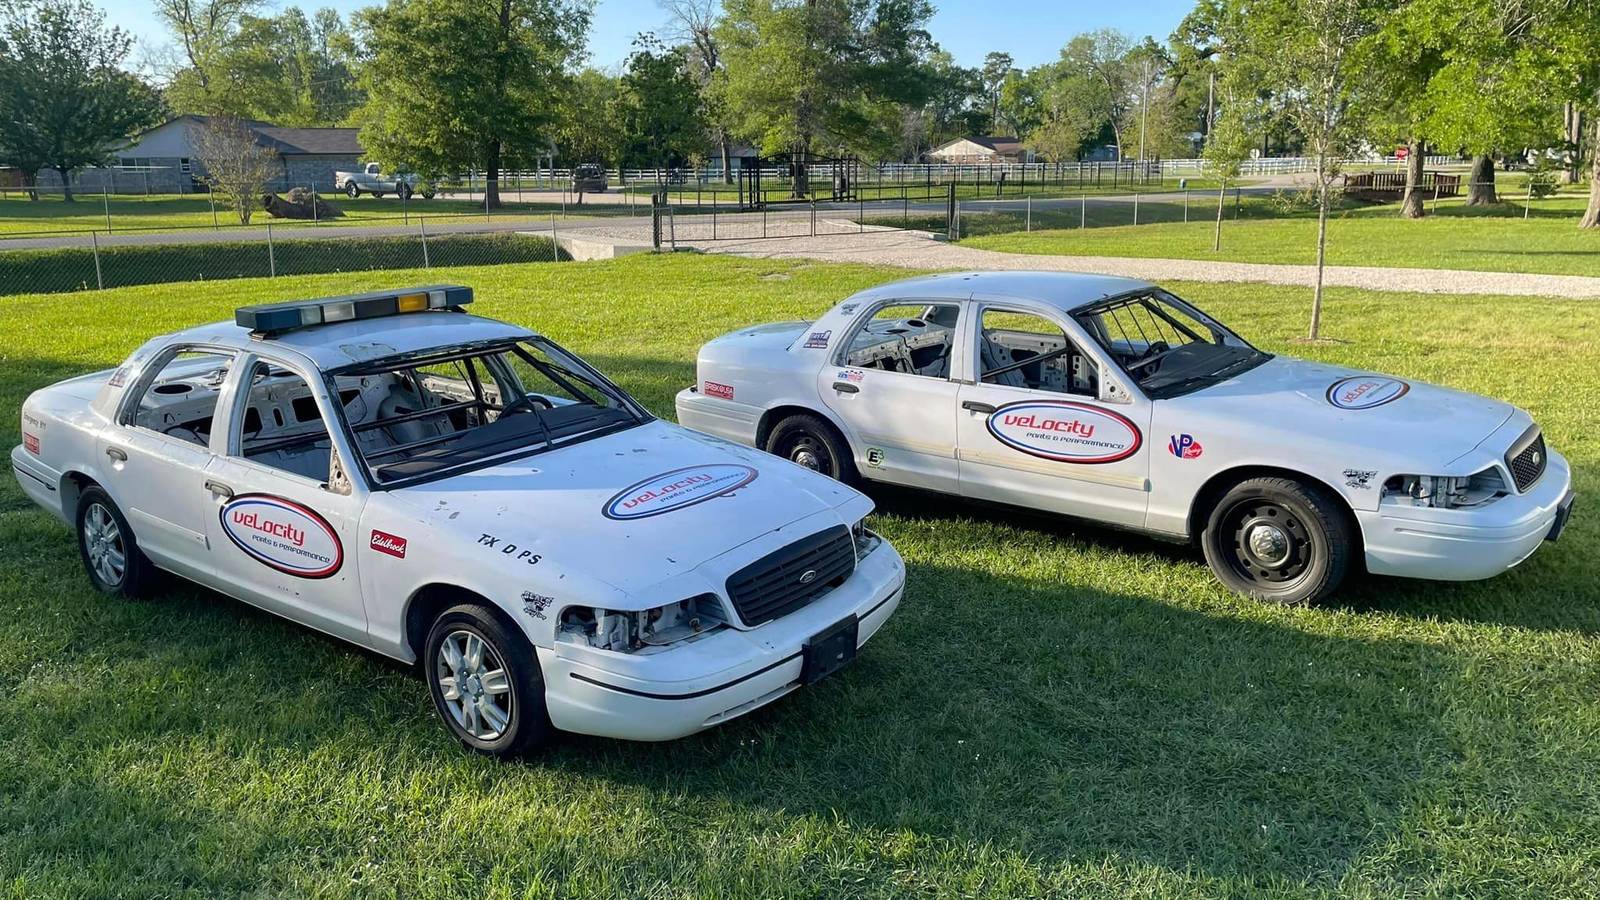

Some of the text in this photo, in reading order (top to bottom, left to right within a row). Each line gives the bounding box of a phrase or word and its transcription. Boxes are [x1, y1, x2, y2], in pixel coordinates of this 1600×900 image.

[1171, 434, 1193, 458] VP
[372, 534, 405, 554] Edelbrock
[477, 533, 500, 548] TX
